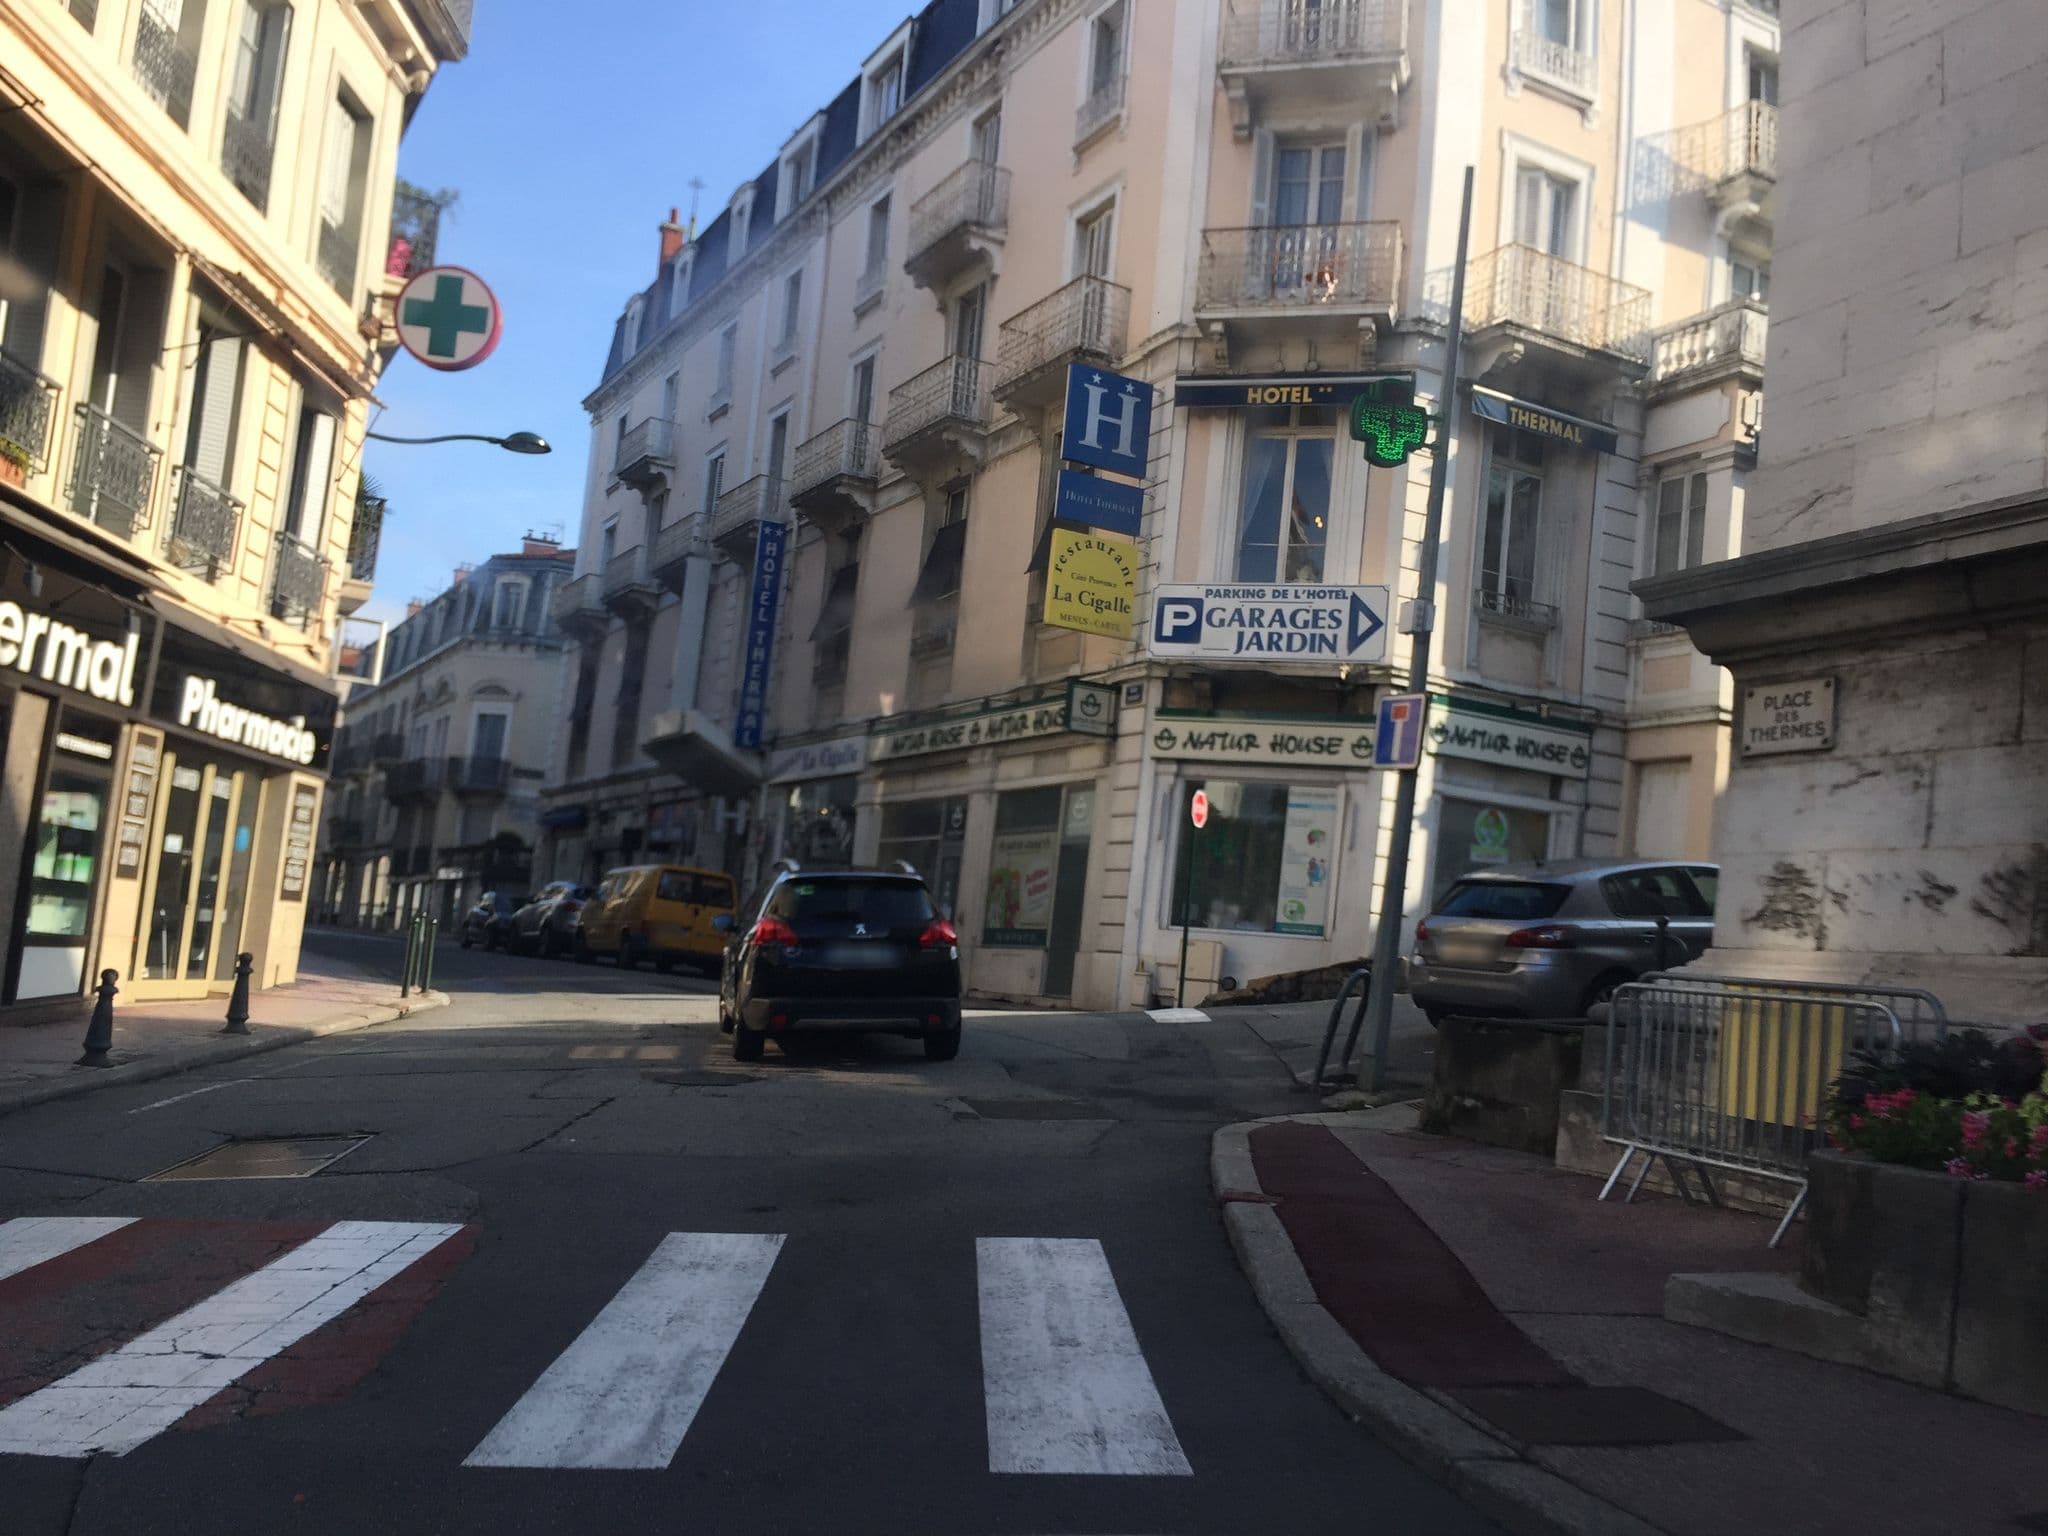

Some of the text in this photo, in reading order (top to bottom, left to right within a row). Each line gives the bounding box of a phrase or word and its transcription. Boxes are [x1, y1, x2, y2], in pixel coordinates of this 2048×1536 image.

[1246, 386, 1312, 404] HOTEL
[1078, 383, 1141, 458] H
[1509, 406, 1583, 445] THERMAL
[1054, 539, 1134, 587] restaurant
[758, 542, 777, 622] HOTEL
[1205, 588, 1349, 600] PARKING DE L'HOTEL
[1053, 584, 1131, 614] La Cigalle
[1161, 604, 1197, 637] P
[1205, 606, 1343, 630] GARAGES
[1233, 630, 1338, 654] JARDIN
[1763, 690, 1813, 711] PLACE
[179, 674, 317, 765] Pharmacie
[1775, 710, 1800, 723] DES
[1182, 730, 1346, 755] NATUR HOUSE
[1450, 724, 1569, 764] NATUR HOUSE
[1749, 719, 1826, 742] THERMES
